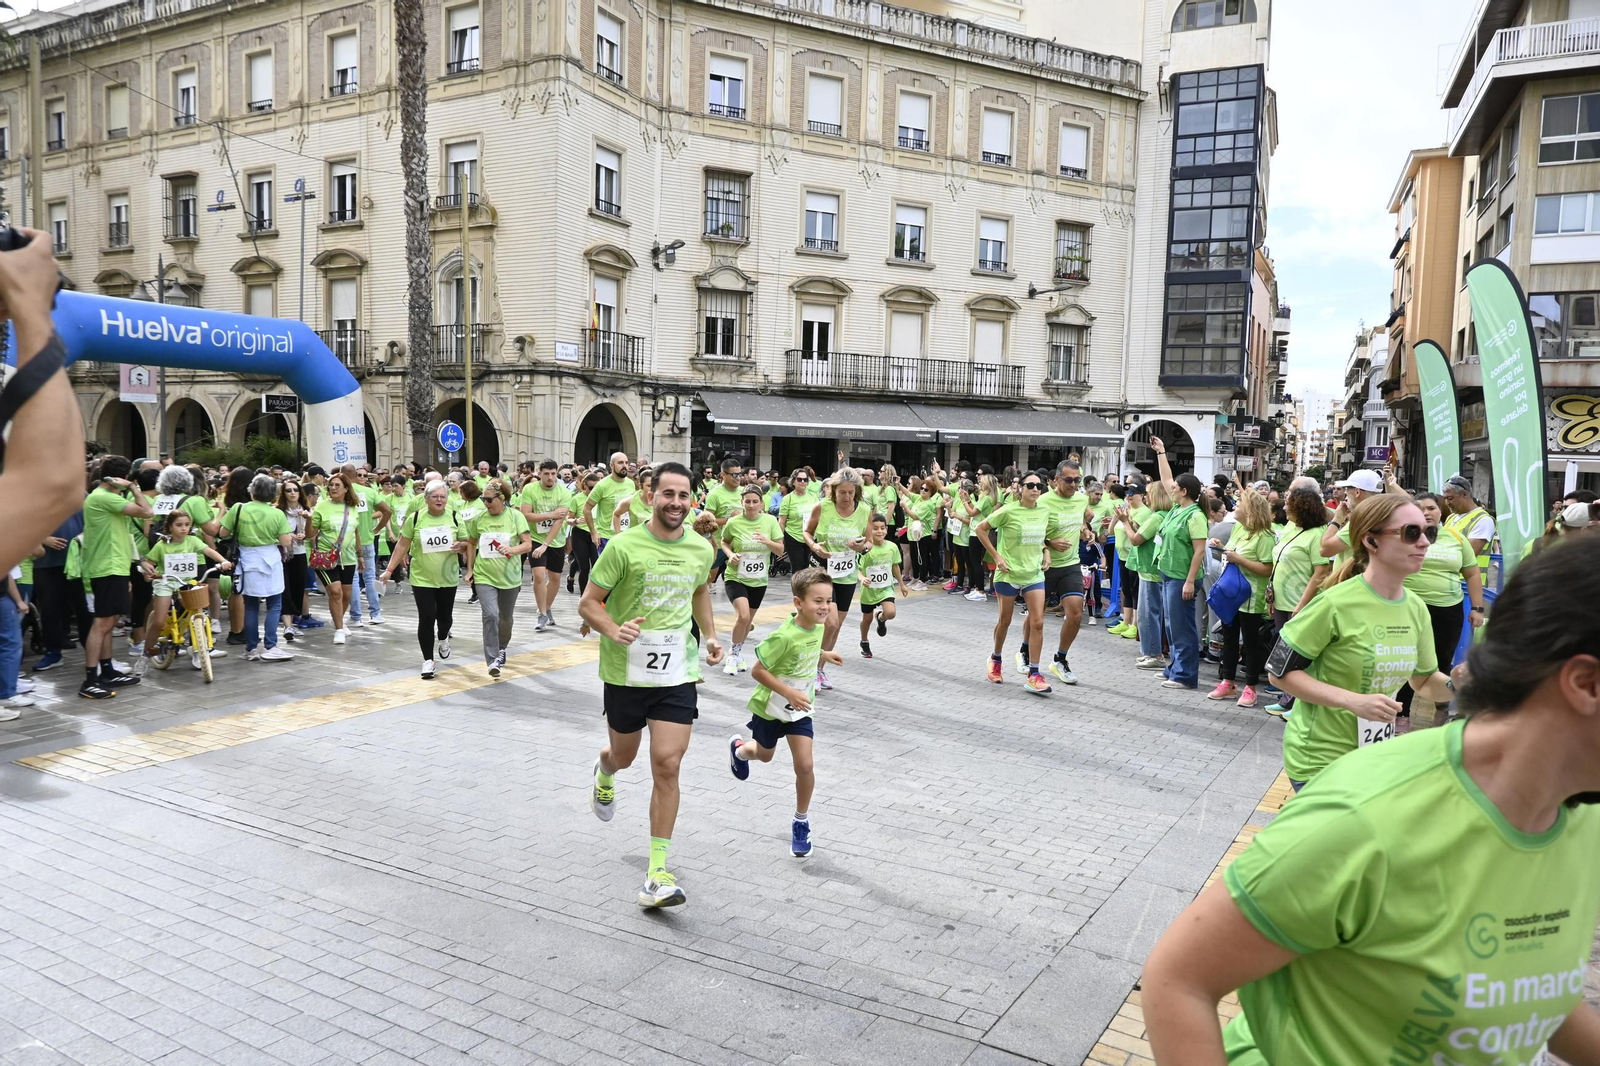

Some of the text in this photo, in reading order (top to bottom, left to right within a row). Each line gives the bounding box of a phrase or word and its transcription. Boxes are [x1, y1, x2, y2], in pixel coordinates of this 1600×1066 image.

[100, 309, 293, 355] Huelva original
[426, 535, 448, 546] 406
[645, 572, 658, 582] En
[870, 573, 888, 582] 200
[1376, 644, 1417, 655] En marc
[646, 652, 671, 670] 27
[1465, 973, 1505, 1008] En
